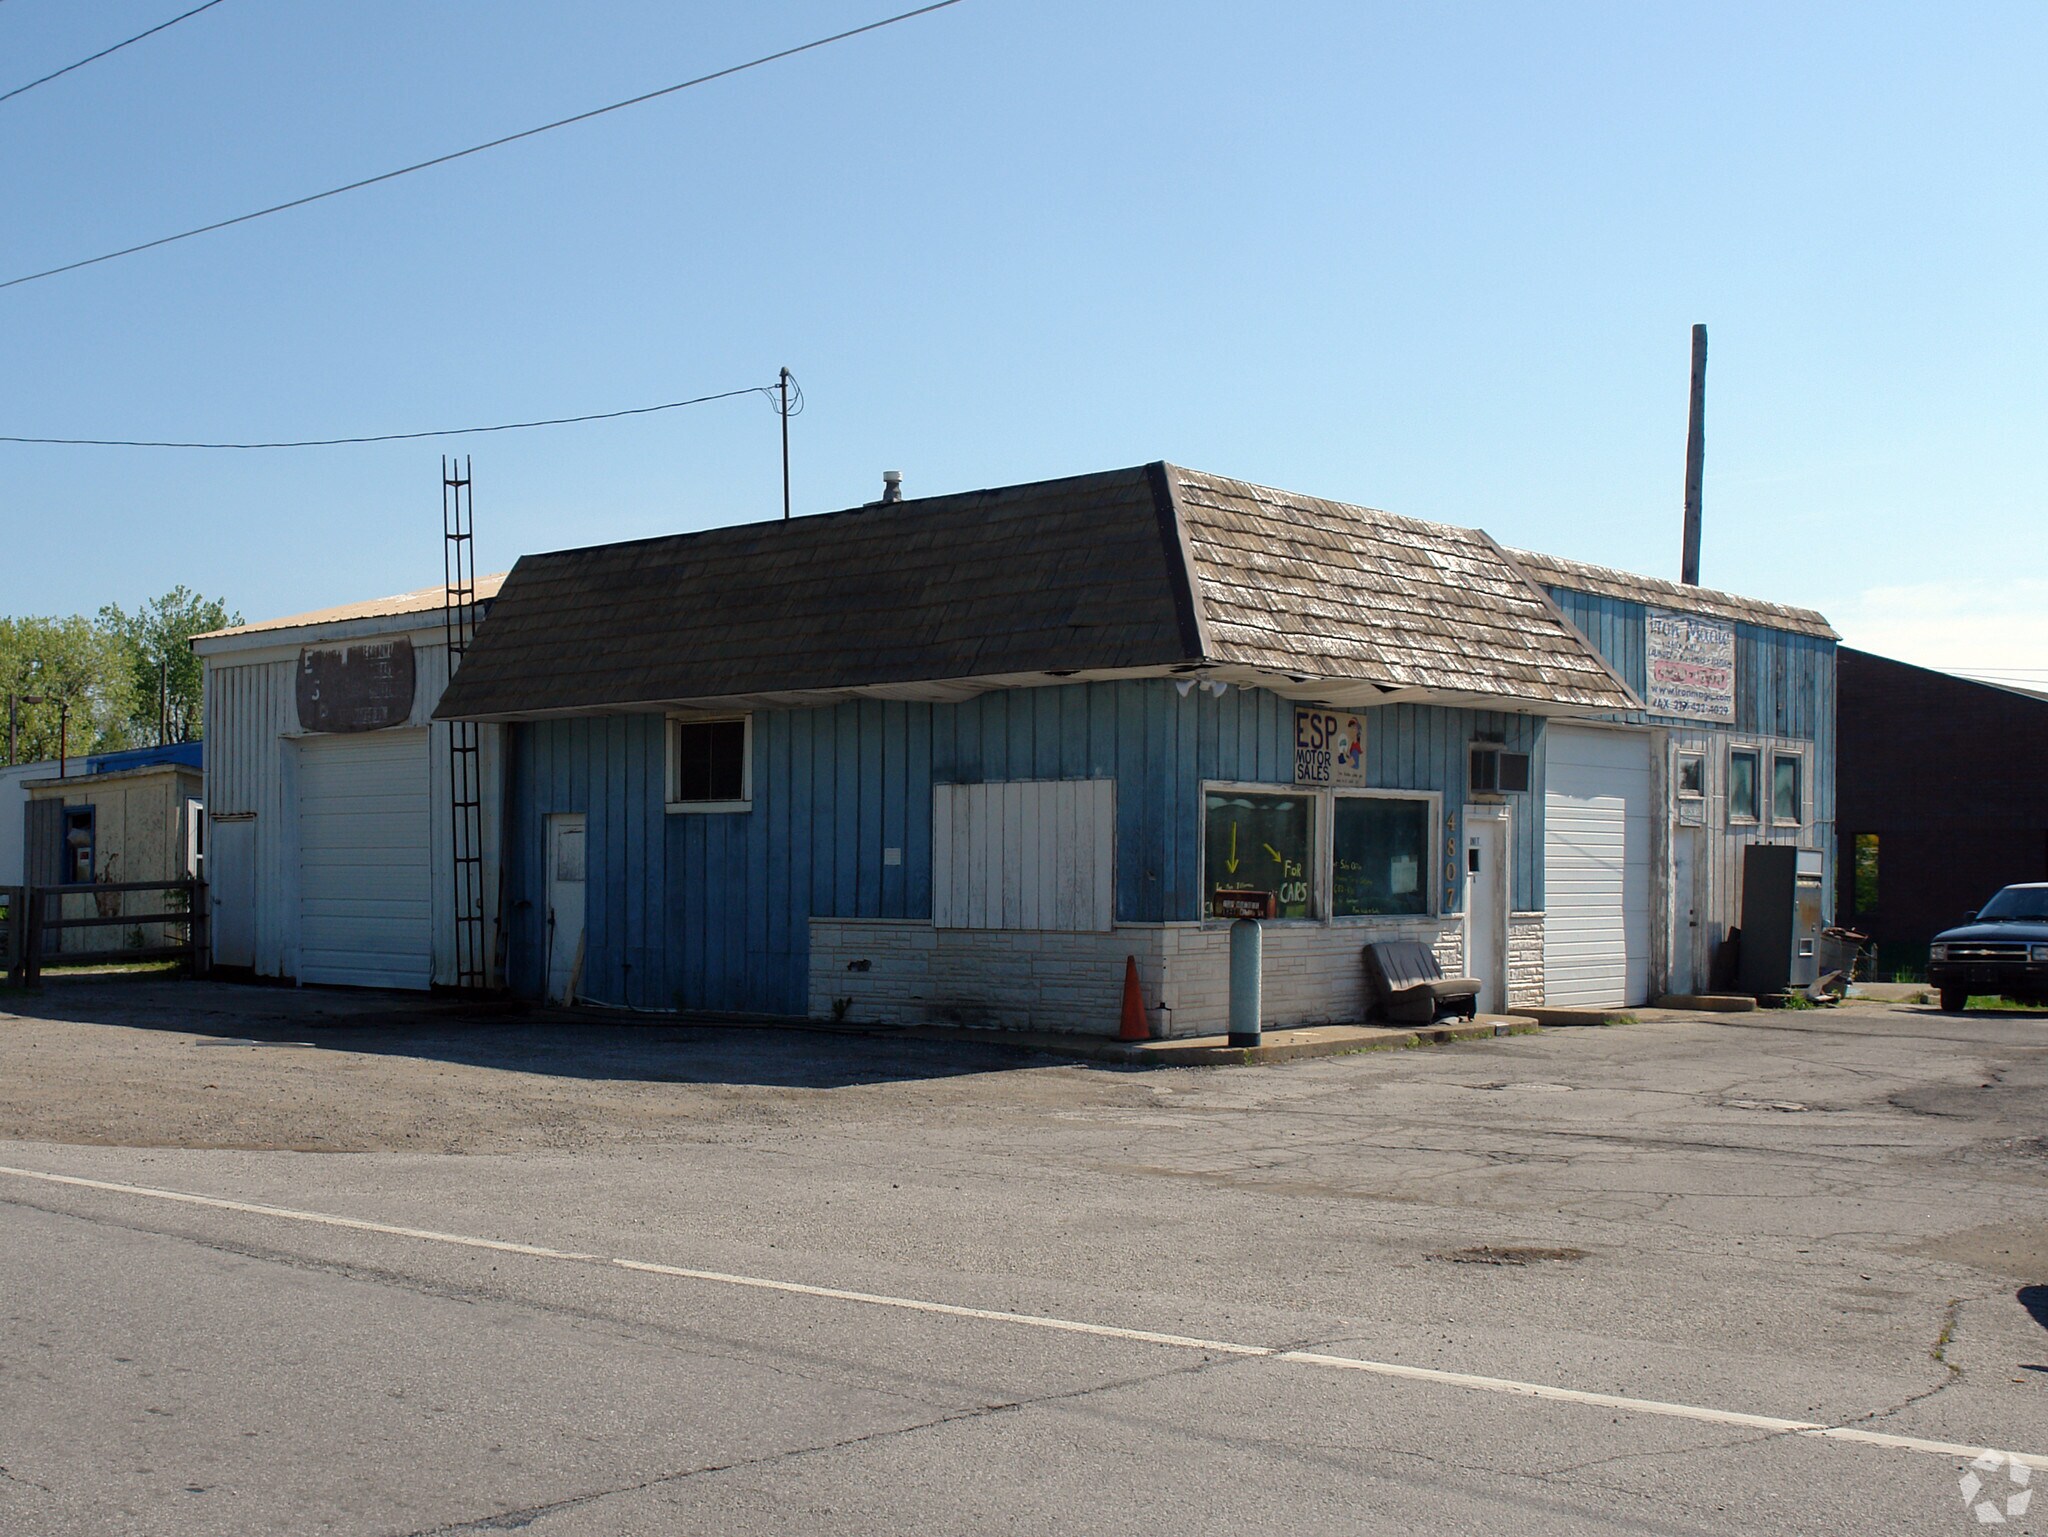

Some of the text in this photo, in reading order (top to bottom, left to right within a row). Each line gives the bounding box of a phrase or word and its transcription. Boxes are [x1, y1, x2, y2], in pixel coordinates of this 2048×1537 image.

[1296, 711, 1337, 750] ESP
[1296, 749, 1331, 766] MOTOR
[1297, 763, 1330, 781] SALES
[1280, 881, 1308, 903] CARS
